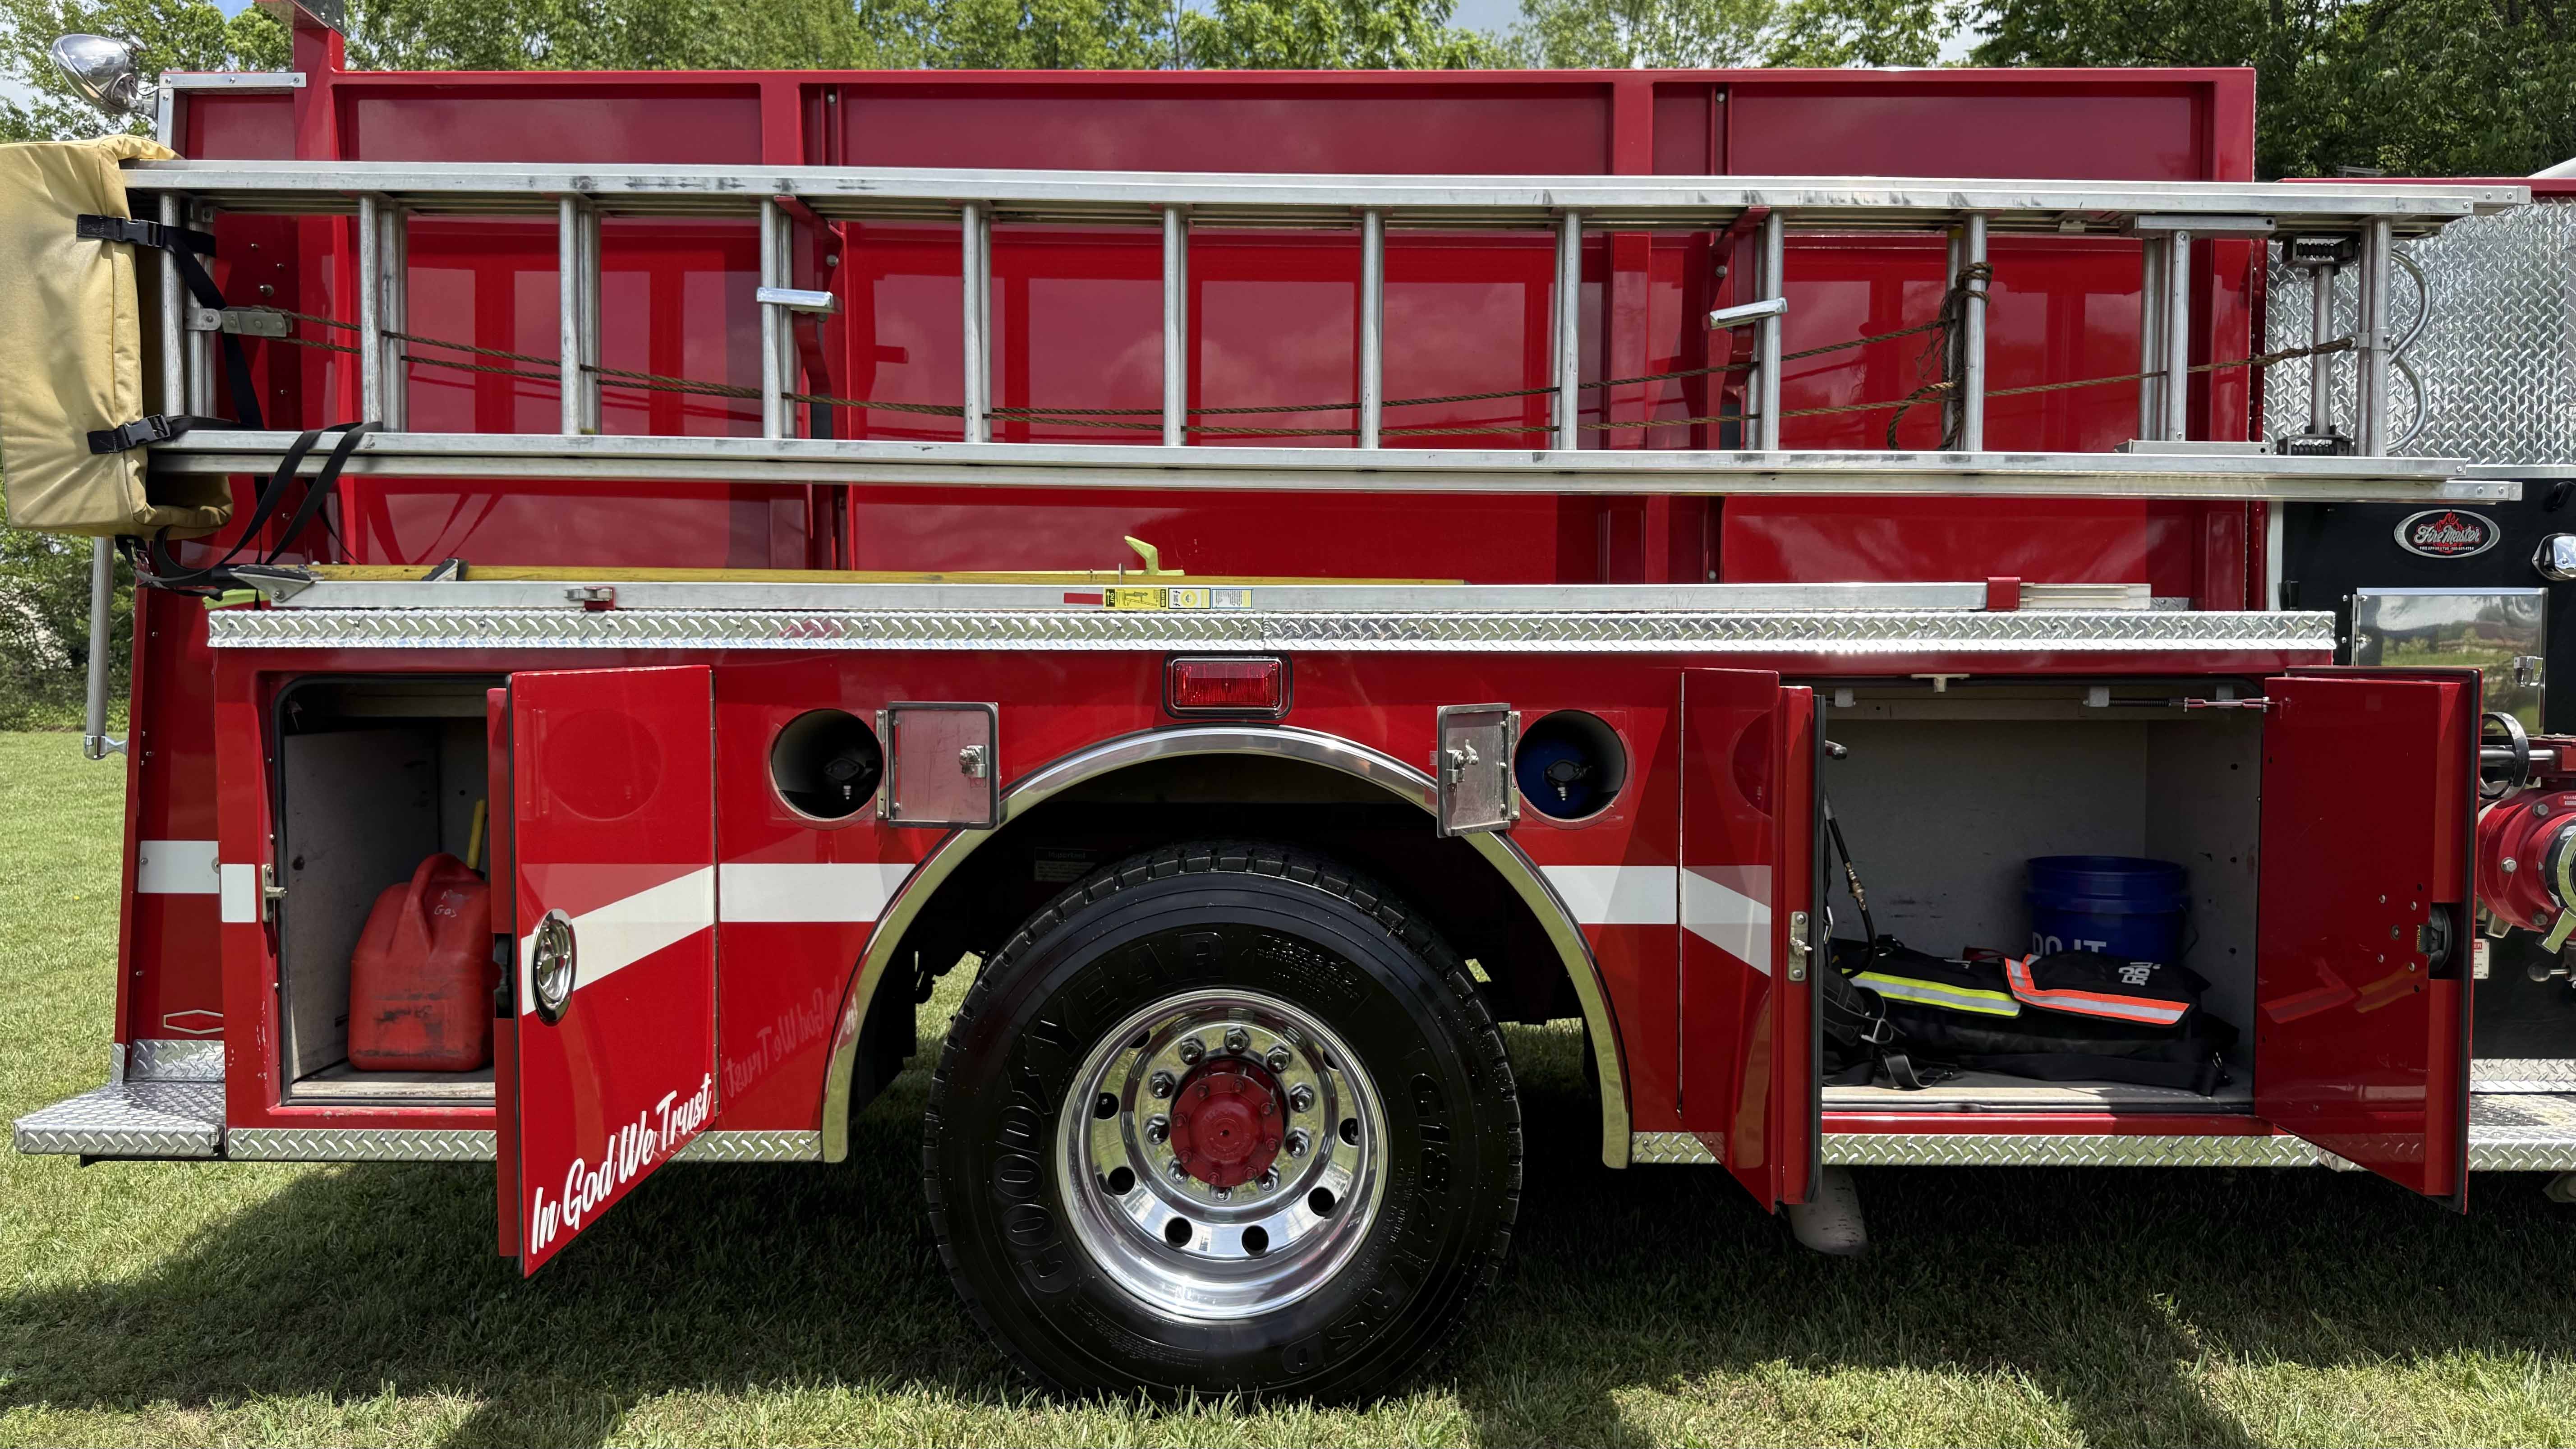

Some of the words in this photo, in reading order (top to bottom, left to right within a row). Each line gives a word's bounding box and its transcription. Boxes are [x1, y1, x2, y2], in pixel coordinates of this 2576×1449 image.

[434, 904, 457, 918] Gas
[530, 1187, 561, 1254] In
[562, 1134, 617, 1230] God
[619, 1111, 656, 1184] We
[656, 1072, 713, 1152] Trust
[993, 929, 1225, 1296] GOODYEAR
